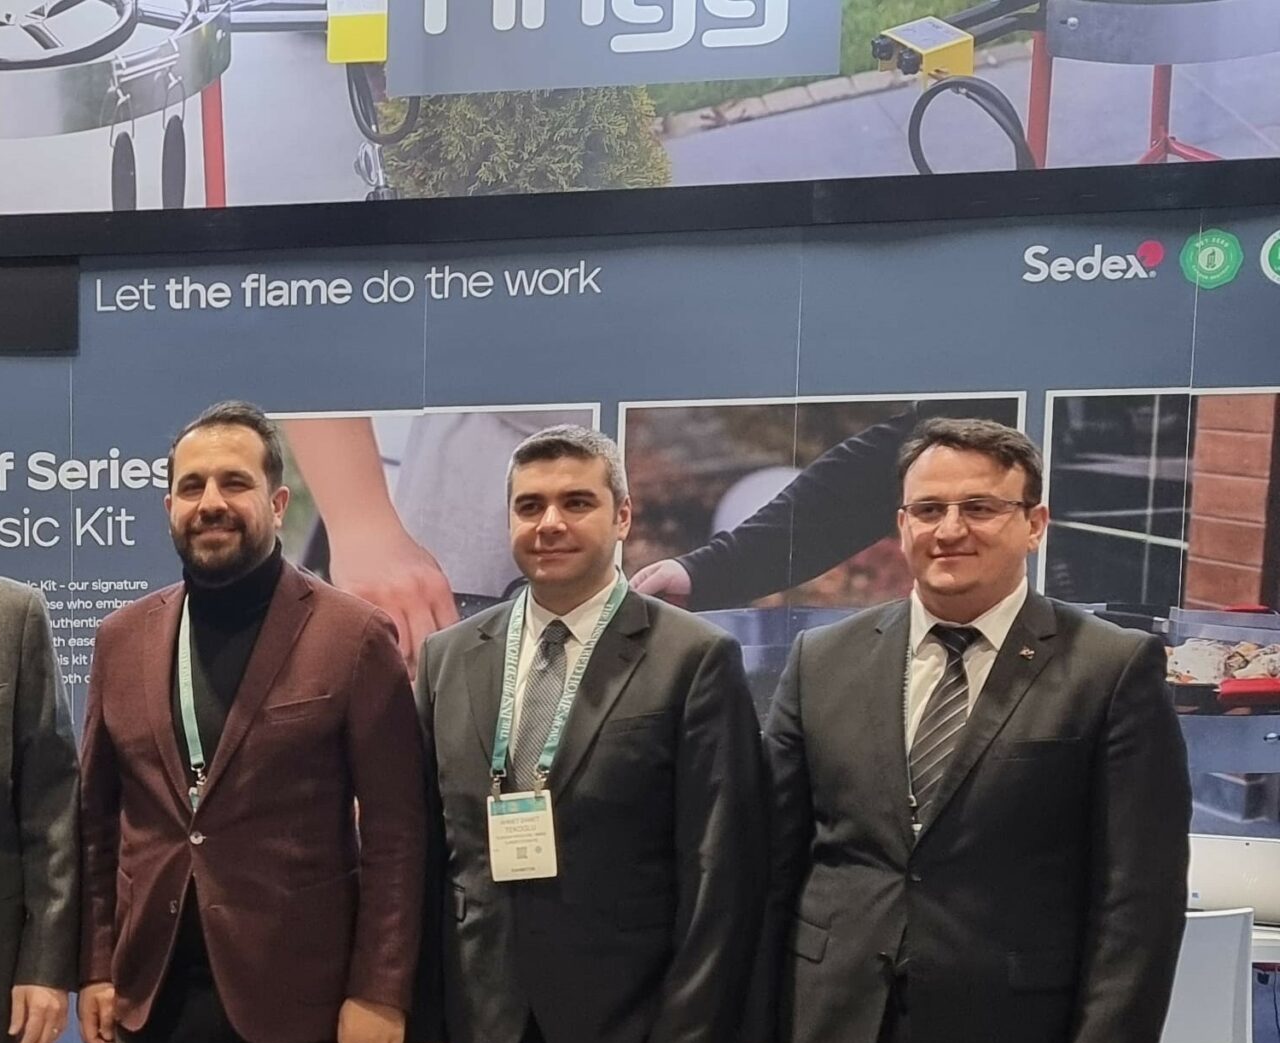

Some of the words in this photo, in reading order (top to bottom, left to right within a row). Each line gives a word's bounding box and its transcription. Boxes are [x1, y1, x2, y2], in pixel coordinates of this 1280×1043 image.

[1022, 243, 1149, 282] Sedex
[96, 278, 156, 311] Let
[166, 275, 231, 309] the
[241, 273, 352, 307] flame
[363, 270, 415, 303] do
[425, 266, 494, 299] the
[504, 260, 602, 296] work
[27, 448, 169, 490] Series
[75, 506, 135, 546] Kit
[40, 580, 57, 591] Kit
[68, 581, 89, 591] our
[91, 579, 149, 593] signature
[67, 598, 92, 609] who
[72, 654, 88, 665] kit
[506, 628, 522, 665] HOME
[500, 665, 518, 718] INSPIRED
